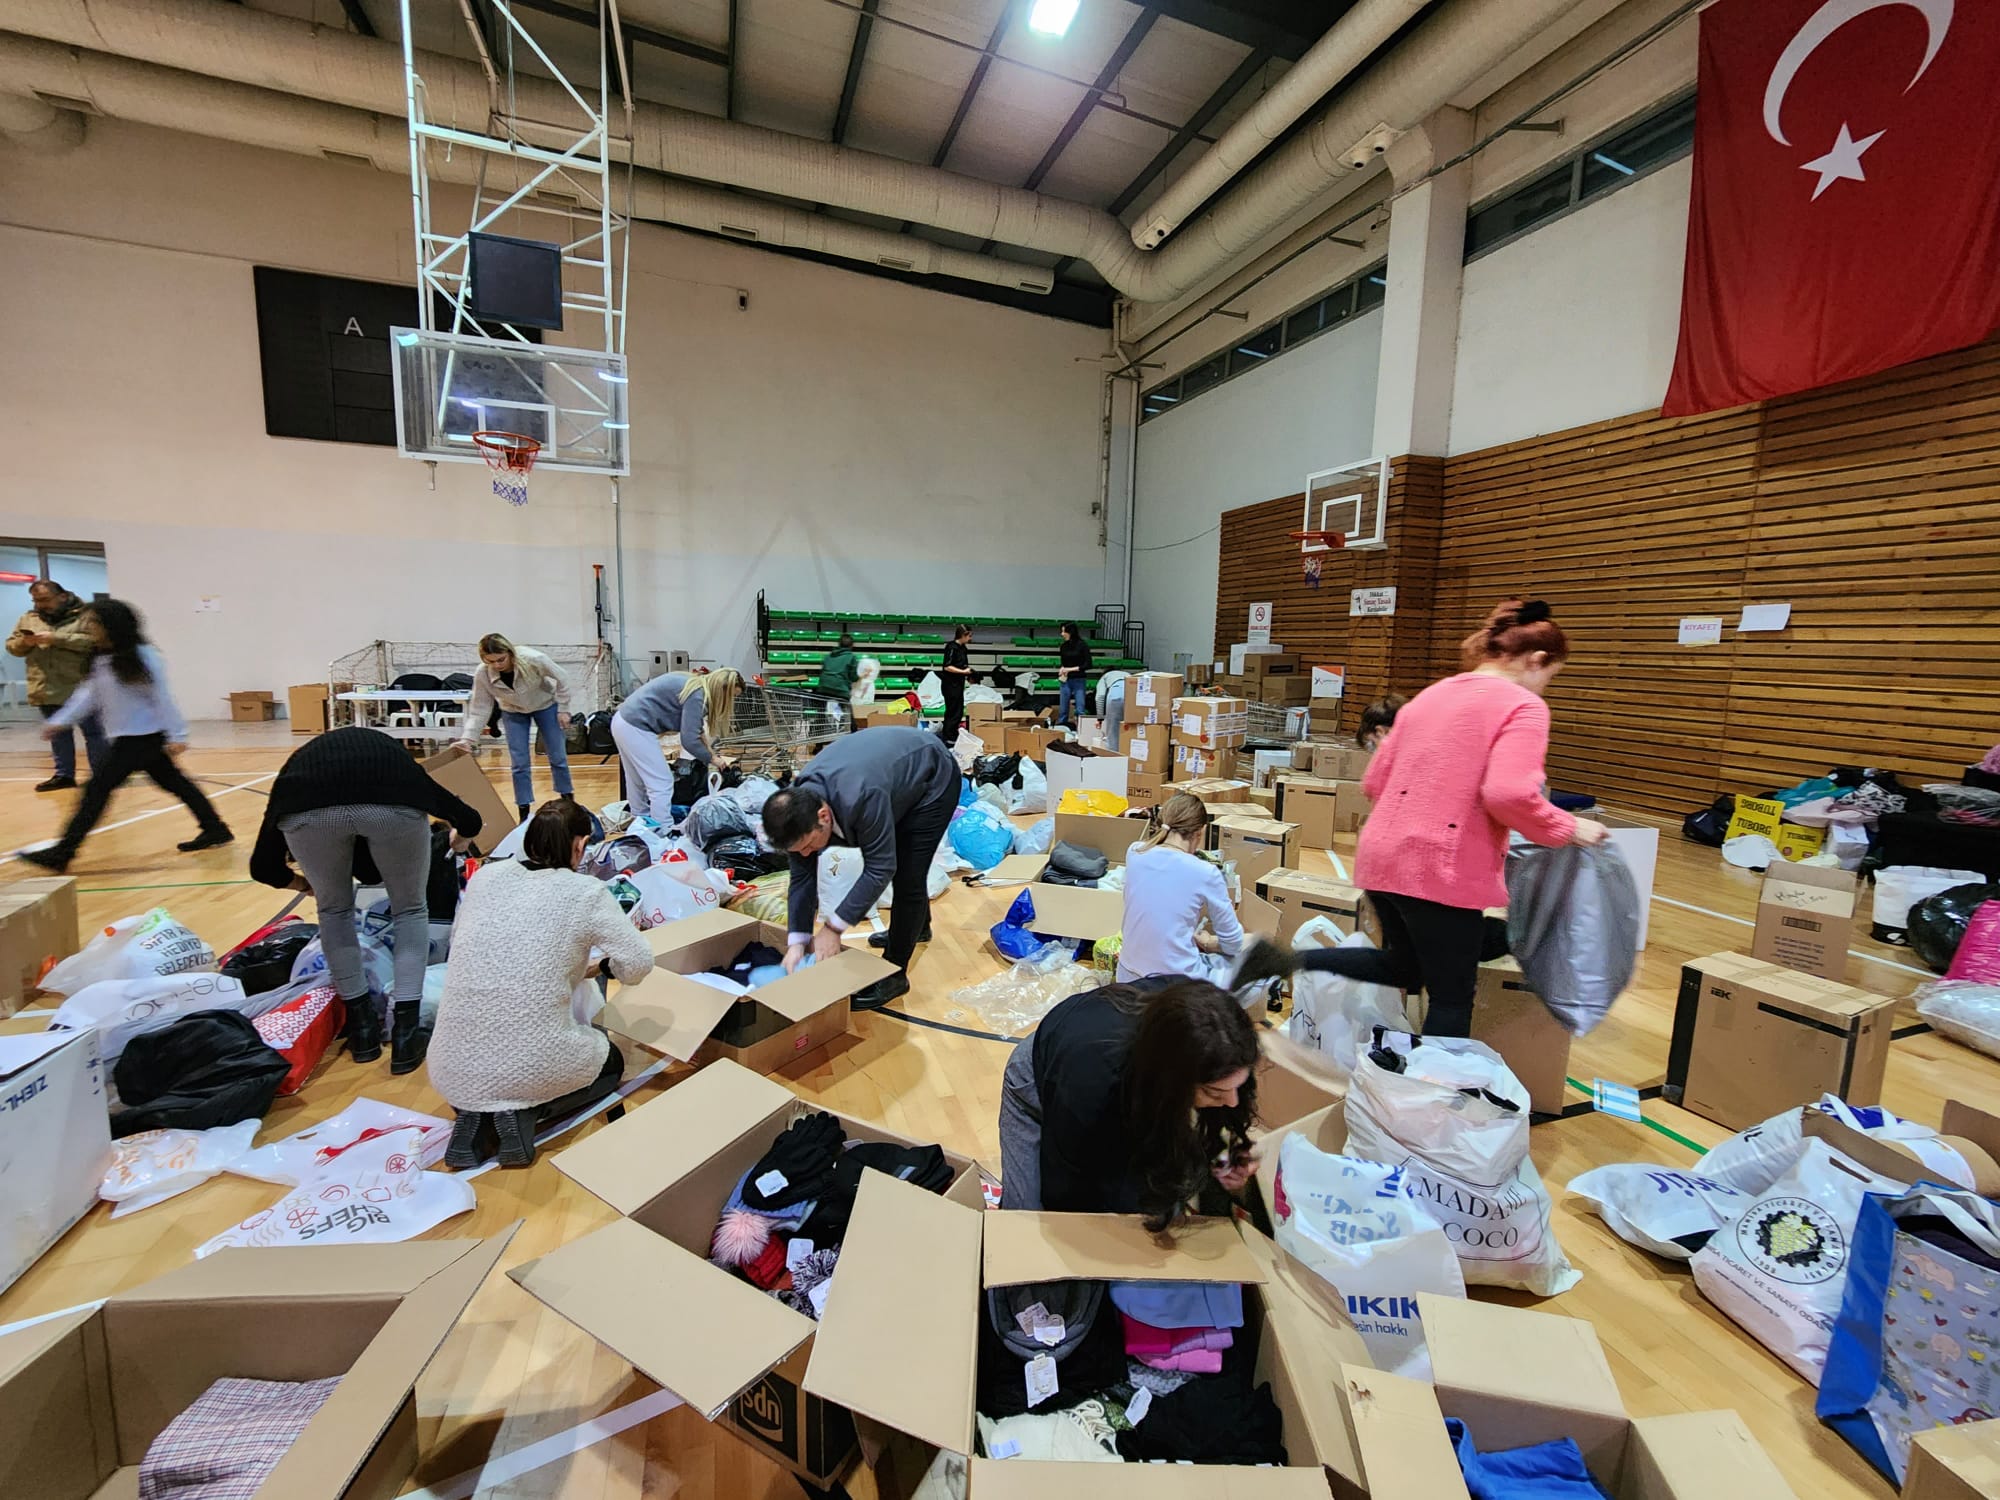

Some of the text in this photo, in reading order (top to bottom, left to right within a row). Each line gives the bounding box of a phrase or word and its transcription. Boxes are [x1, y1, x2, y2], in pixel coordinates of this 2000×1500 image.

[343, 316, 364, 337] A
[1740, 798, 1777, 816] TUBORG
[1736, 817, 1772, 836] TUBORG
[298, 1204, 383, 1240] CHEFS
[346, 1213, 391, 1234] BIG
[1442, 1222, 1519, 1249] COCO
[1375, 1320, 1409, 1337] hakkı
